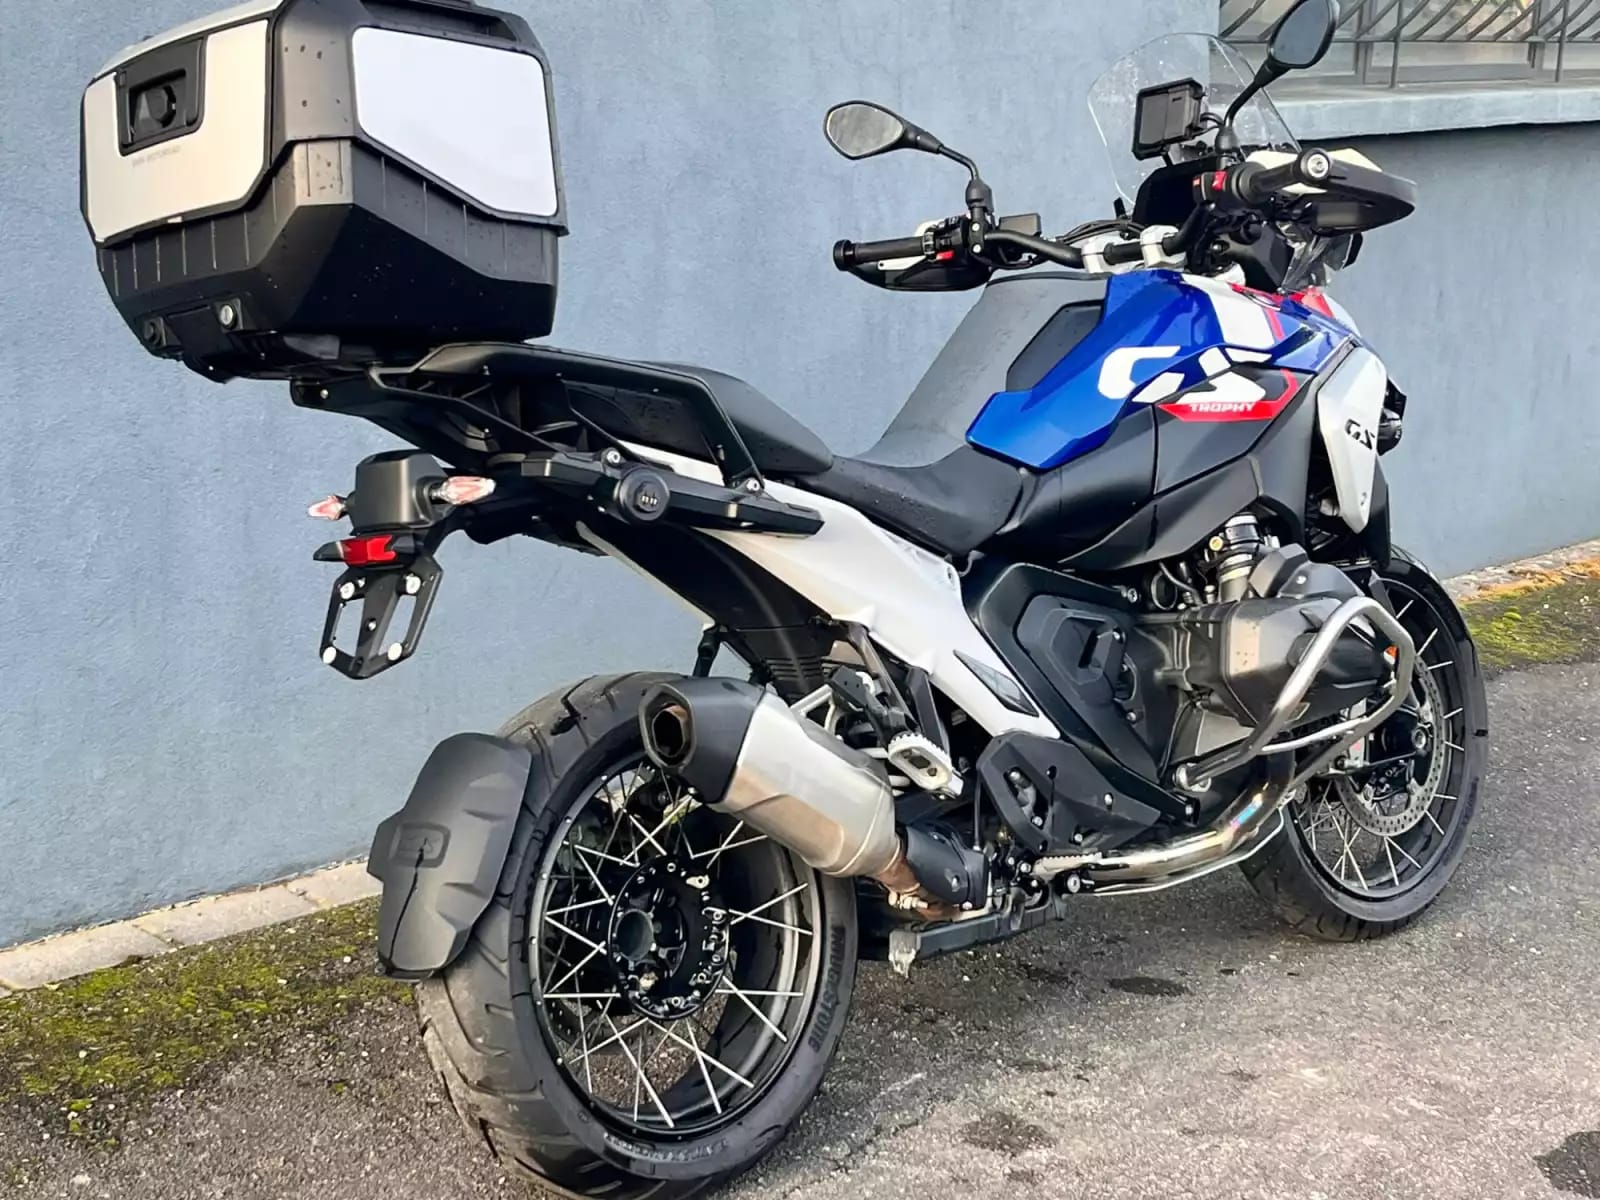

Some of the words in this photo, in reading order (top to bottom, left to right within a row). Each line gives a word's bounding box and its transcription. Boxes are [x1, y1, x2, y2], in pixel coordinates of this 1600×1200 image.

[1097, 345, 1272, 405] GS
[1189, 401, 1256, 412] TROPHY
[1345, 418, 1375, 450] GS
